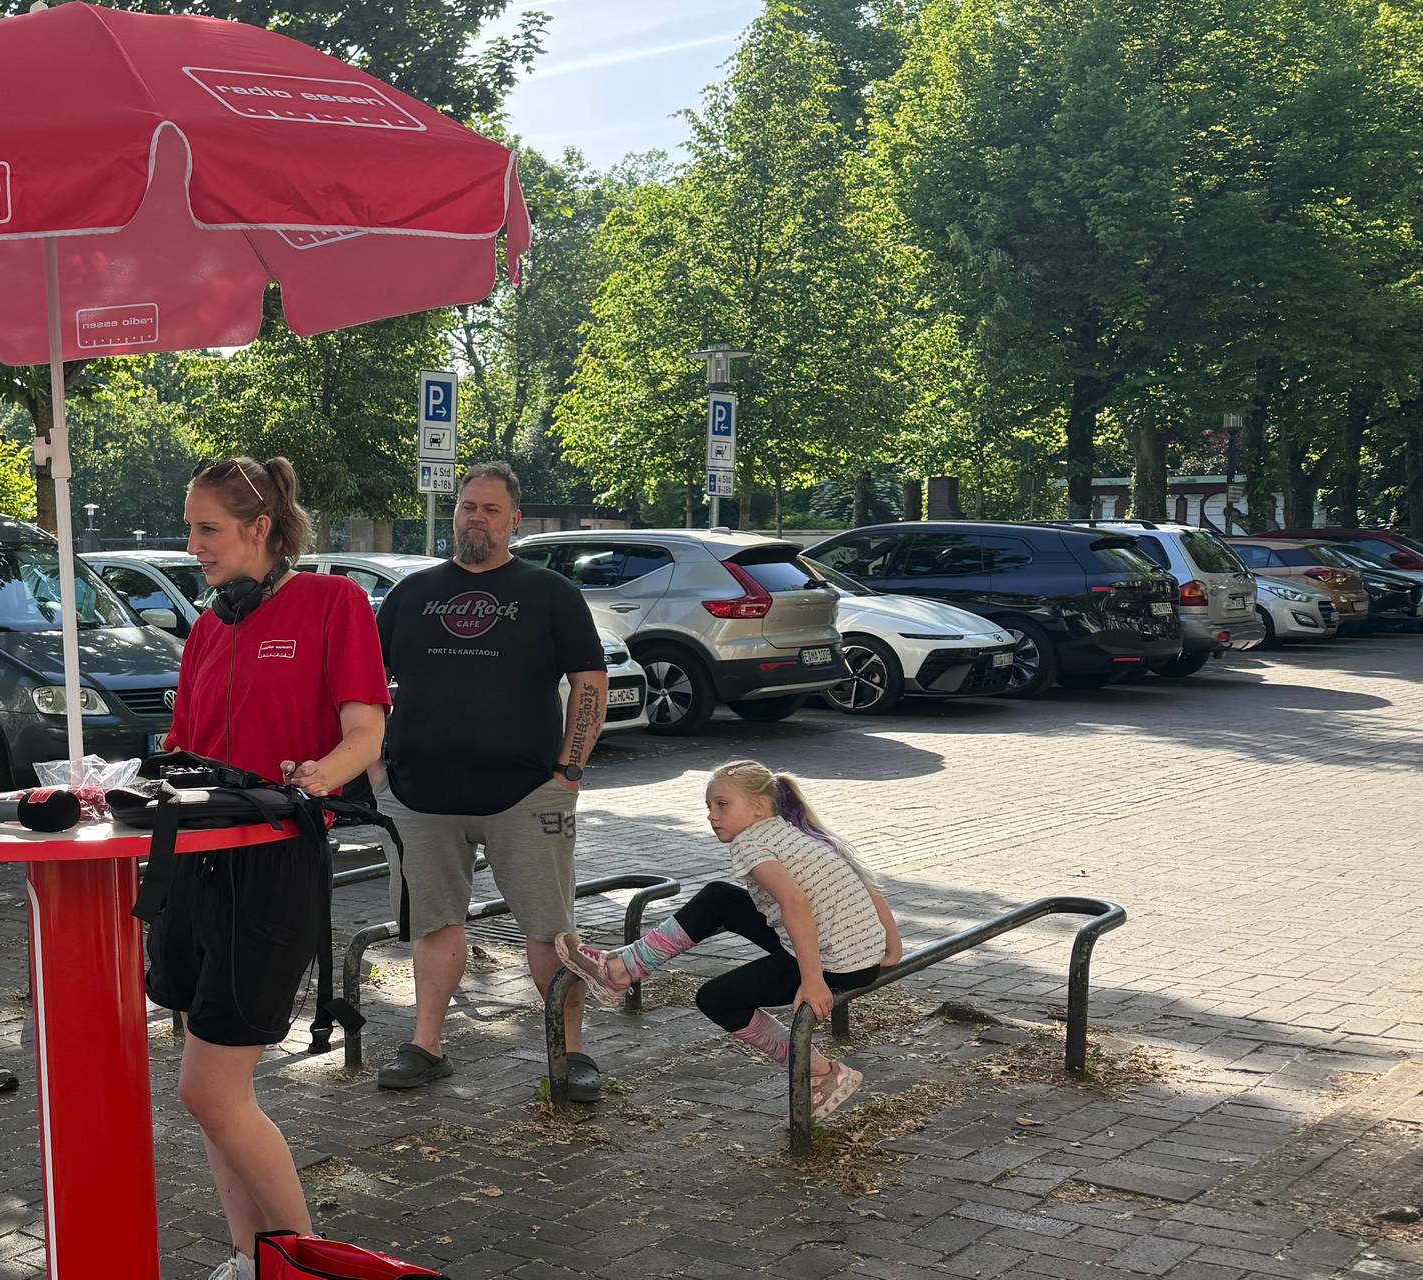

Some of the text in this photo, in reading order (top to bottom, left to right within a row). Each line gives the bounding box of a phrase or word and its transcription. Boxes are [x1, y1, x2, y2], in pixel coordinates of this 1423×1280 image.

[215, 84, 385, 106] radio essen
[429, 385, 444, 416] P
[715, 405, 726, 431] P
[433, 467, 452, 477] 4 Std.
[421, 599, 519, 621] Hard Rock
[427, 647, 447, 655] PORT
[457, 648, 499, 657] KANTAOUI
[609, 691, 614, 703] E
[156, 735, 163, 751] K
